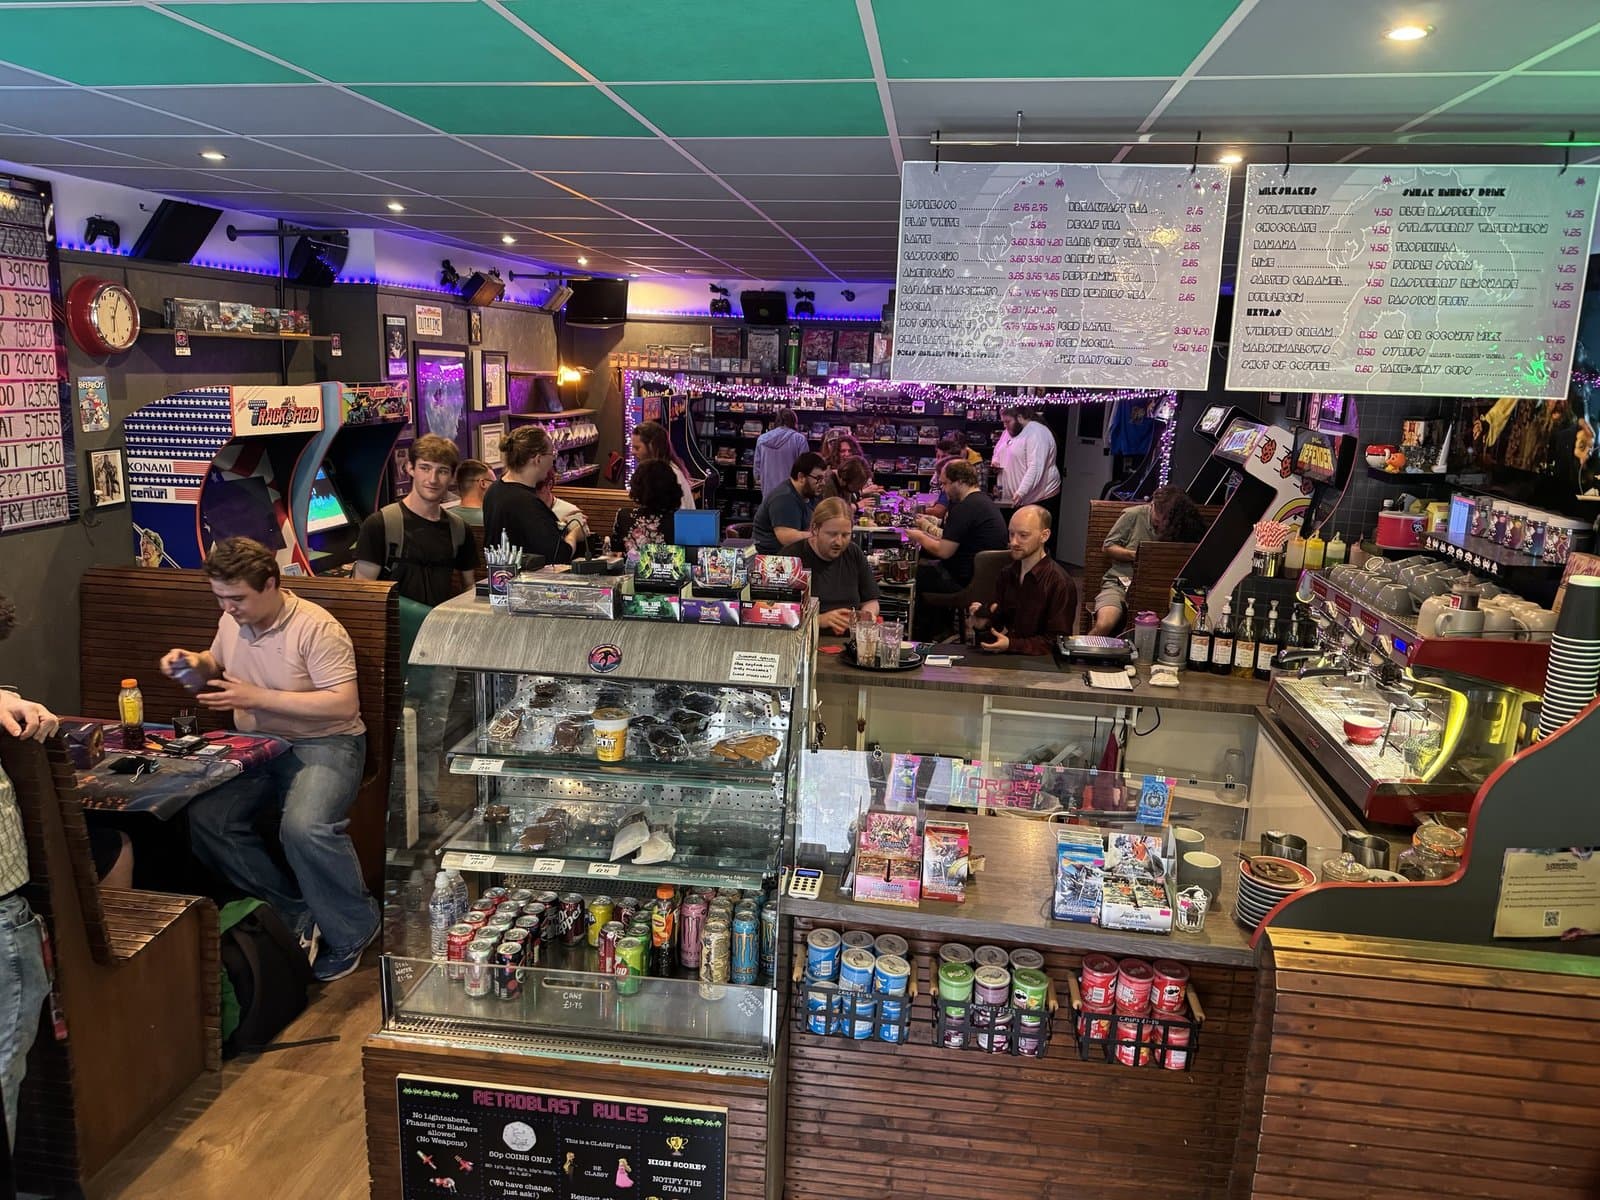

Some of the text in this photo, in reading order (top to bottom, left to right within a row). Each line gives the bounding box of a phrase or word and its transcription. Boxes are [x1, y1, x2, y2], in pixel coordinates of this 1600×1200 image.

[1258, 187, 1318, 195] MILKSHAKES
[1402, 188, 1507, 197] SNEAK ENERGY DRINK
[905, 200, 957, 210] ESPRESSO
[1013, 203, 1030, 212] 2.45
[1068, 202, 1127, 213] BREAKFAST
[1129, 203, 1148, 213] TEA
[1257, 204, 1393, 217] STRAWBERRY 4.50
[1399, 206, 1585, 218] BLUE RASPBERRY 4.25
[930, 217, 960, 227] WHITE
[1066, 219, 1100, 229] DECAF
[1101, 220, 1121, 230] TEA
[1255, 222, 1391, 234] CHOCOLATE 4.50
[1398, 222, 1582, 237] STRAWBERRY WATERMELON 4.25
[904, 234, 932, 244] LATTE
[1065, 237, 1091, 246] EARL
[1093, 237, 1121, 247] GREY
[1123, 238, 1142, 248] TEA
[1253, 240, 1389, 252] BANANA 4.50
[1560, 246, 1579, 256] 4.25
[1064, 254, 1095, 264] GREEN
[1098, 255, 1117, 264] TEA
[1251, 257, 1387, 270] LIME 4.50
[1393, 260, 1577, 273] PURPLE STORM 4.25
[6, 260, 48, 288] 396000
[903, 268, 955, 278] AMERICANO
[1250, 275, 1385, 288] SALTED CARAMEL 4.50
[1390, 278, 1457, 288] RASPBERRY
[1555, 282, 1574, 292] 4.25
[1061, 288, 1081, 298] RED
[1127, 289, 1146, 299] TEA
[1248, 292, 1382, 305] BUBBLEGUM 4.50
[14, 293, 50, 319] 33490
[1388, 295, 1436, 305] PASSION
[1552, 300, 1572, 310] 4.25
[1246, 308, 1282, 316] EXTRAS
[1082, 322, 1112, 332] LATTE
[1245, 326, 1293, 336] WHIPPED
[1295, 327, 1334, 337] CREAM
[1384, 330, 1405, 339] OAT
[1407, 330, 1422, 340] OR
[1425, 331, 1474, 341] COCONUT
[1242, 343, 1332, 353] MARSHMALLOWS
[1382, 347, 1426, 357] SYRUPS
[15, 353, 56, 375] 200400
[1241, 360, 1270, 369] SHOT
[1272, 361, 1287, 369] OF
[1289, 361, 1330, 371] COFFEE
[248, 400, 320, 427] TRACK FIELD
[128, 463, 172, 474] KONAMI
[968, 776, 1042, 795] ORDER
[977, 795, 1032, 808] HERE
[473, 1089, 649, 1124] RETROBLAST RULES
[412, 1111, 471, 1125] No Lightsabers,
[406, 1118, 436, 1129] Phasers
[447, 1122, 478, 1133] Blasters
[427, 1130, 457, 1139] allowed
[431, 1137, 468, 1148] Weapons)
[505, 1152, 530, 1162] COINS
[530, 1154, 553, 1165] ONLY
[647, 1158, 707, 1172] HIGH SCORE?
[505, 1181, 523, 1190] have
[652, 1175, 702, 1188] NOTIFY THE
[662, 1184, 692, 1195] STAFF!
